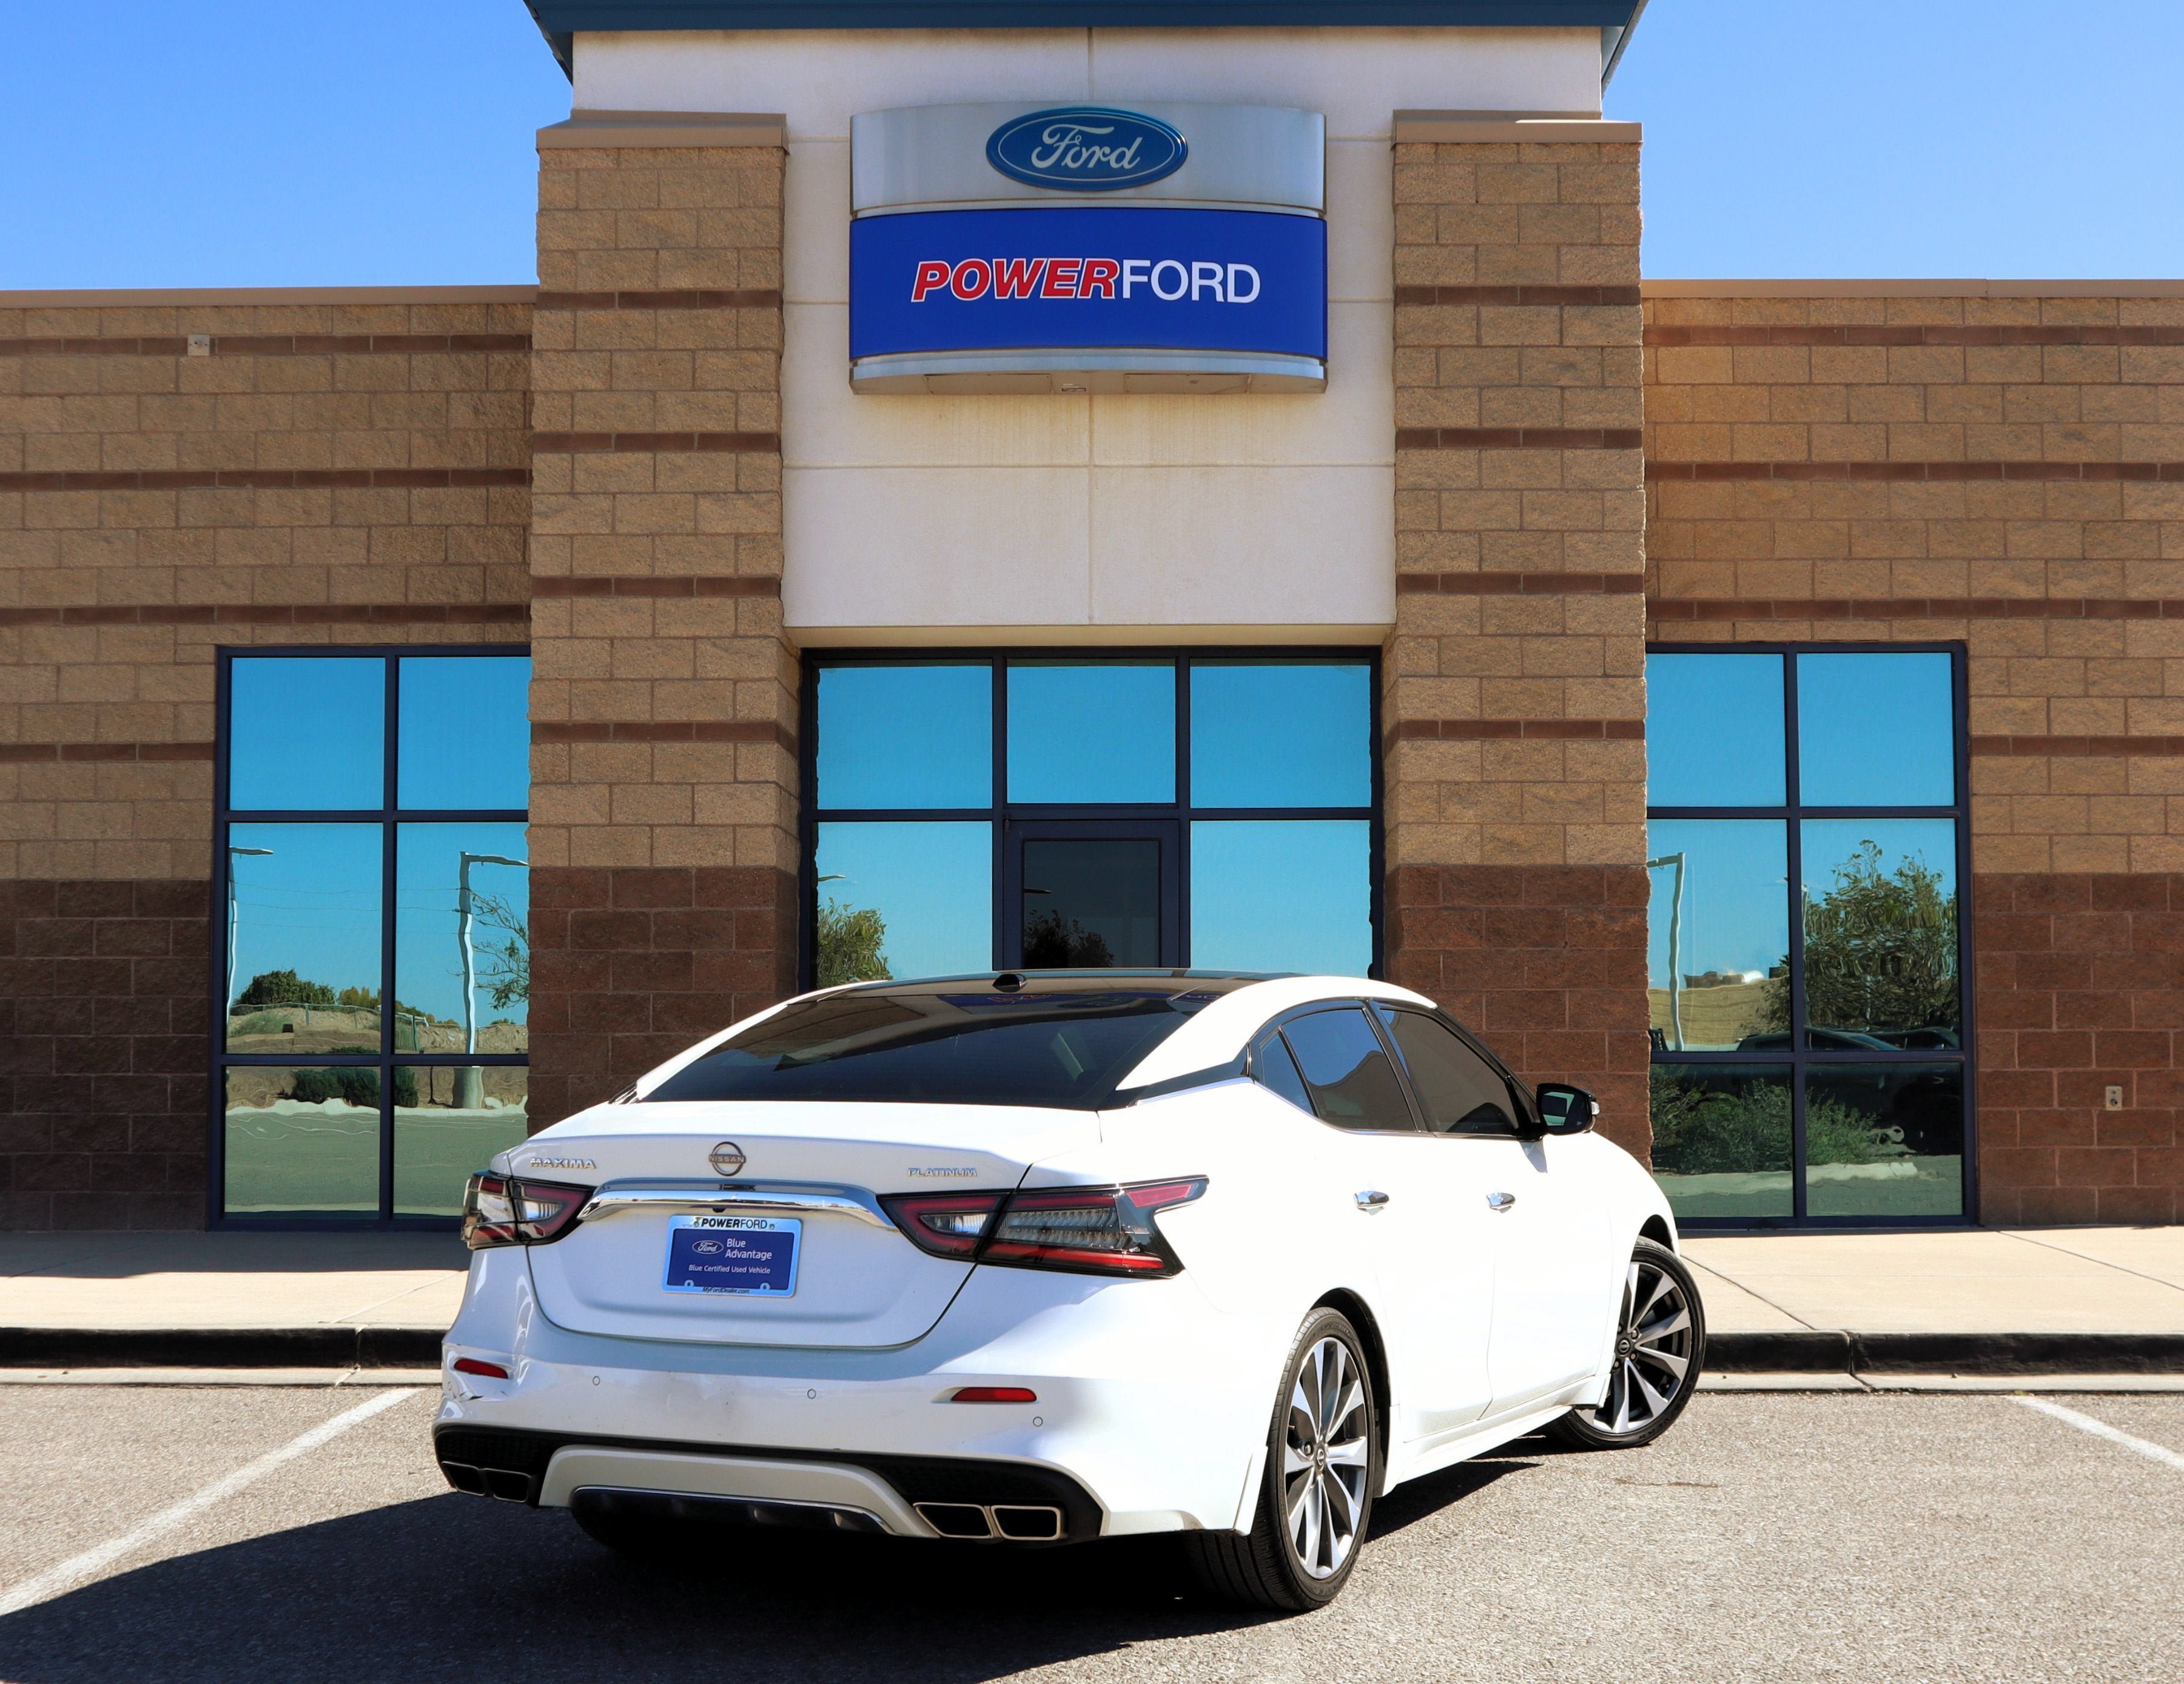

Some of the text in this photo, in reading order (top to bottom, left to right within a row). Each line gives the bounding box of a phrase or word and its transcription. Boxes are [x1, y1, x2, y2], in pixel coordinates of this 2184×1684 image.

[1031, 124, 1144, 169] Ford
[530, 1157, 597, 1169] MAXIMA
[907, 1167, 978, 1177] PLATINUM
[697, 1242, 717, 1251] Ford
[726, 1238, 747, 1248] Blue
[725, 1248, 773, 1261] Advantage
[704, 1264, 730, 1273] Certified
[748, 1266, 771, 1275] Vehicle
